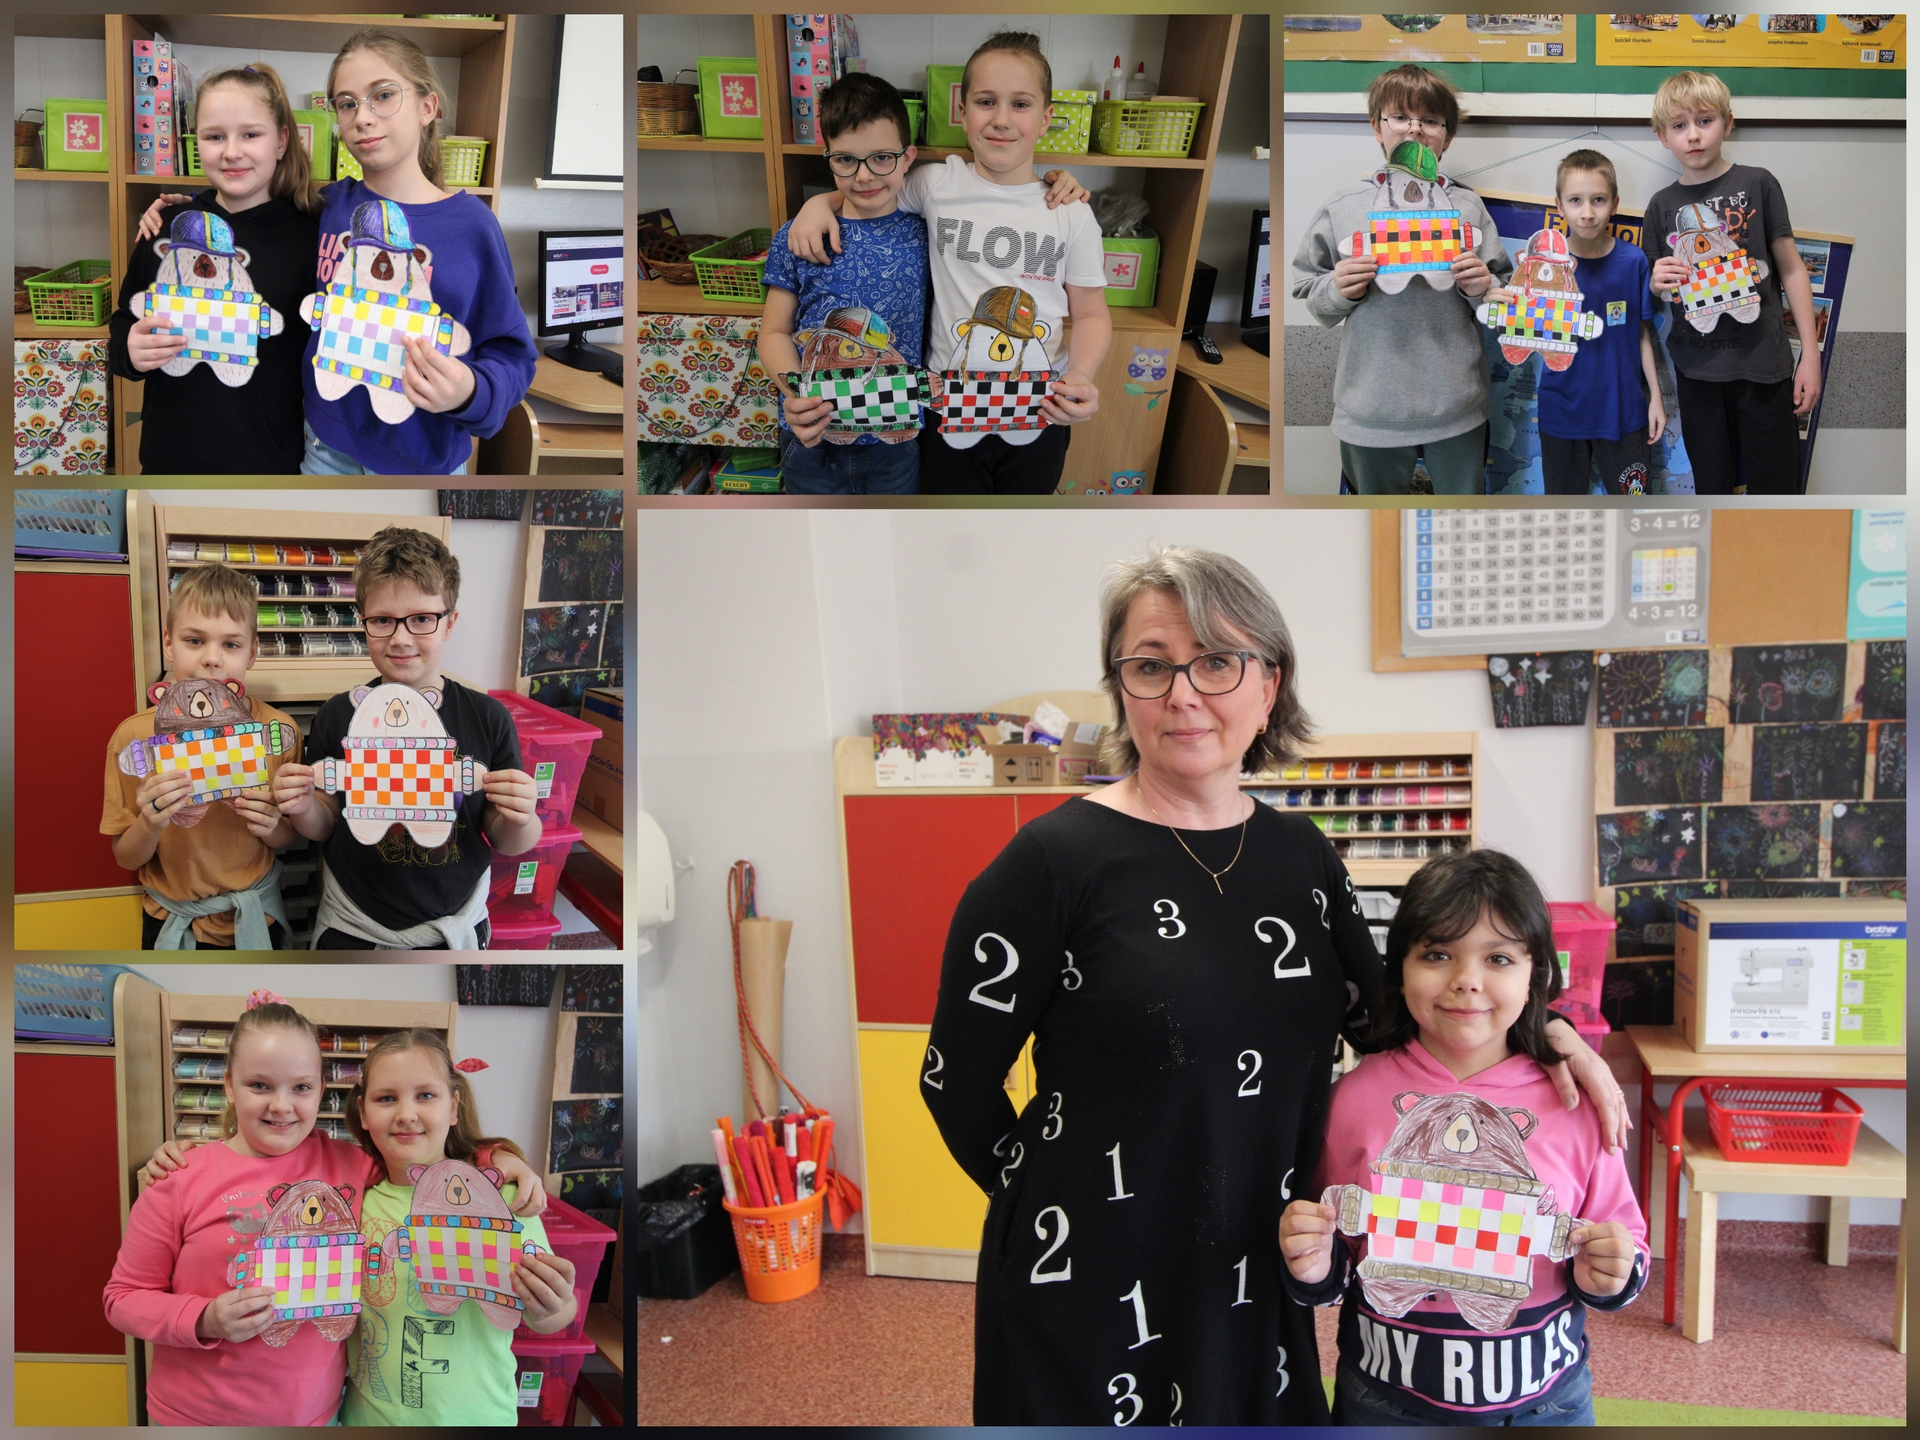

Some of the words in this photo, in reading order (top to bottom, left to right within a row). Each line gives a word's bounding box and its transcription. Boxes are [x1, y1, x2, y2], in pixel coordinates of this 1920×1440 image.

[937, 217, 1066, 277] FLOW
[1471, 532, 1480, 540] 12
[1488, 531, 1497, 539] 16
[1505, 530, 1515, 538] 20
[1523, 529, 1533, 537] 24
[1540, 528, 1550, 536] 28
[1557, 527, 1567, 535] 32
[1575, 525, 1585, 534] 36
[1592, 524, 1602, 533] 40
[1488, 517, 1497, 525] 12
[1506, 516, 1515, 524] 15
[1523, 515, 1532, 523] 18
[1540, 513, 1550, 522] 21
[1557, 512, 1567, 521] 24
[1575, 511, 1585, 520] 27
[1592, 510, 1602, 518] 30
[1630, 518, 1640, 531] 3
[1653, 517, 1662, 529] 4
[1681, 514, 1700, 528] 12
[1454, 547, 1463, 556] 10
[1471, 546, 1480, 555] 15
[1488, 545, 1498, 554] 20
[1505, 544, 1515, 552] 25
[1522, 543, 1532, 551] 30
[1540, 542, 1550, 550] 35
[1557, 541, 1567, 549] 40
[1575, 540, 1585, 548] 45
[1592, 539, 1602, 547] 50
[1454, 561, 1463, 570] 12
[1471, 560, 1480, 569] 18
[1488, 559, 1498, 568] 24
[1505, 558, 1515, 567] 30
[1522, 557, 1532, 566] 36
[1540, 556, 1550, 564] 42
[1557, 555, 1567, 563] 48
[1574, 554, 1584, 562] 54
[1592, 553, 1602, 561] 60
[1454, 575, 1463, 584] 14
[1470, 574, 1480, 583] 21
[1488, 573, 1498, 582] 28
[1505, 572, 1515, 581] 35
[1522, 571, 1532, 580] 42
[1540, 570, 1550, 579] 49
[1557, 569, 1567, 578] 56
[1574, 568, 1584, 577] 63
[1591, 567, 1601, 576] 70
[1454, 589, 1463, 598] 16
[1470, 588, 1480, 597] 24
[1488, 587, 1498, 596] 32
[1505, 586, 1515, 595] 40
[1522, 585, 1532, 594] 48
[1539, 584, 1549, 593] 56
[1557, 584, 1567, 592] 64
[1574, 583, 1584, 591] 72
[1591, 582, 1601, 590] 80
[1436, 618, 1446, 627] 10
[1453, 617, 1463, 626] 20
[1470, 616, 1480, 625] 30
[1488, 616, 1498, 624] 40
[1505, 615, 1515, 623] 50
[1522, 614, 1532, 622] 60
[1539, 613, 1549, 621] 70
[1556, 612, 1566, 620] 80
[1574, 611, 1584, 620] 90
[1589, 610, 1602, 619] 100
[1454, 603, 1463, 612] 18
[1470, 602, 1480, 611] 27
[1488, 601, 1498, 610] 36
[1505, 601, 1515, 609] 45
[1522, 600, 1532, 608] 54
[1539, 599, 1549, 607] 63
[1557, 598, 1567, 606] 72
[1574, 597, 1584, 605] 81
[1591, 596, 1601, 604] 90
[1628, 607, 1638, 619] 4
[1651, 606, 1660, 619] 3
[1679, 604, 1697, 617] 12
[1312, 888, 1330, 930] 2
[1345, 876, 1360, 915] 3
[1153, 899, 1186, 939] 3
[1865, 925, 1898, 934] brother
[1254, 916, 1311, 979] 2
[968, 932, 1019, 1013] 2
[1061, 950, 1082, 990] 3
[924, 1045, 944, 1090] 2
[1237, 1049, 1262, 1097] 2
[1042, 1092, 1063, 1141] 3
[1001, 1142, 1024, 1188] 2
[1105, 1142, 1134, 1201] 1
[221, 1190, 255, 1203] United
[1030, 1205, 1071, 1284] 2
[1231, 1255, 1253, 1307] 1
[1119, 1280, 1162, 1350] 1
[1357, 1313, 1419, 1389] MY
[1443, 1310, 1580, 1405] RULES
[1107, 1373, 1143, 1427] 3
